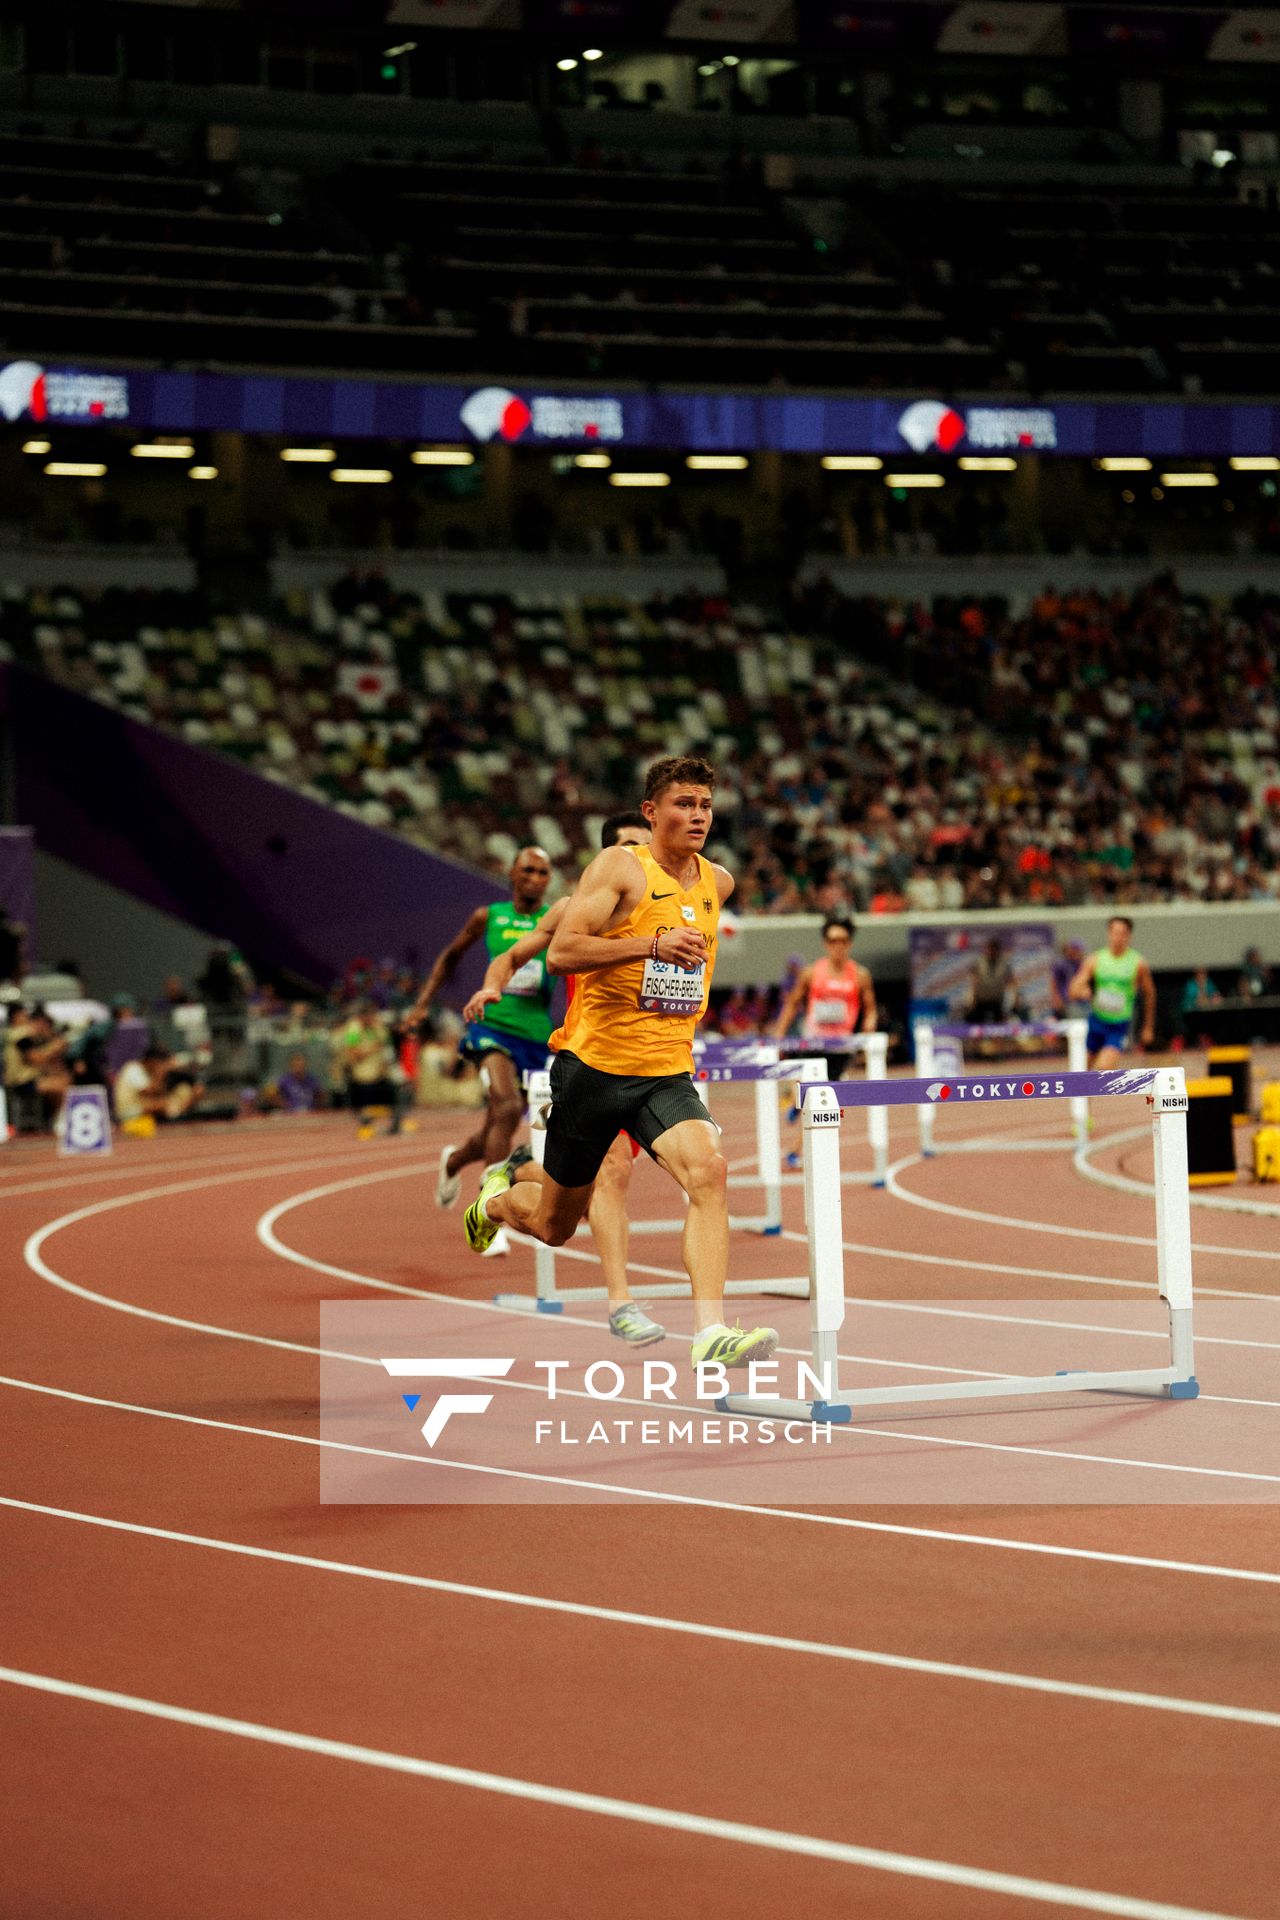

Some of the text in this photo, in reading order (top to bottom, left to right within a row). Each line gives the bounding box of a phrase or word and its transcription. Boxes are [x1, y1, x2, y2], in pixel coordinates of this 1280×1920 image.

[1162, 1097, 1187, 1108] NISHI
[813, 1112, 839, 1123] NISHI
[71, 1102, 102, 1148] 8
